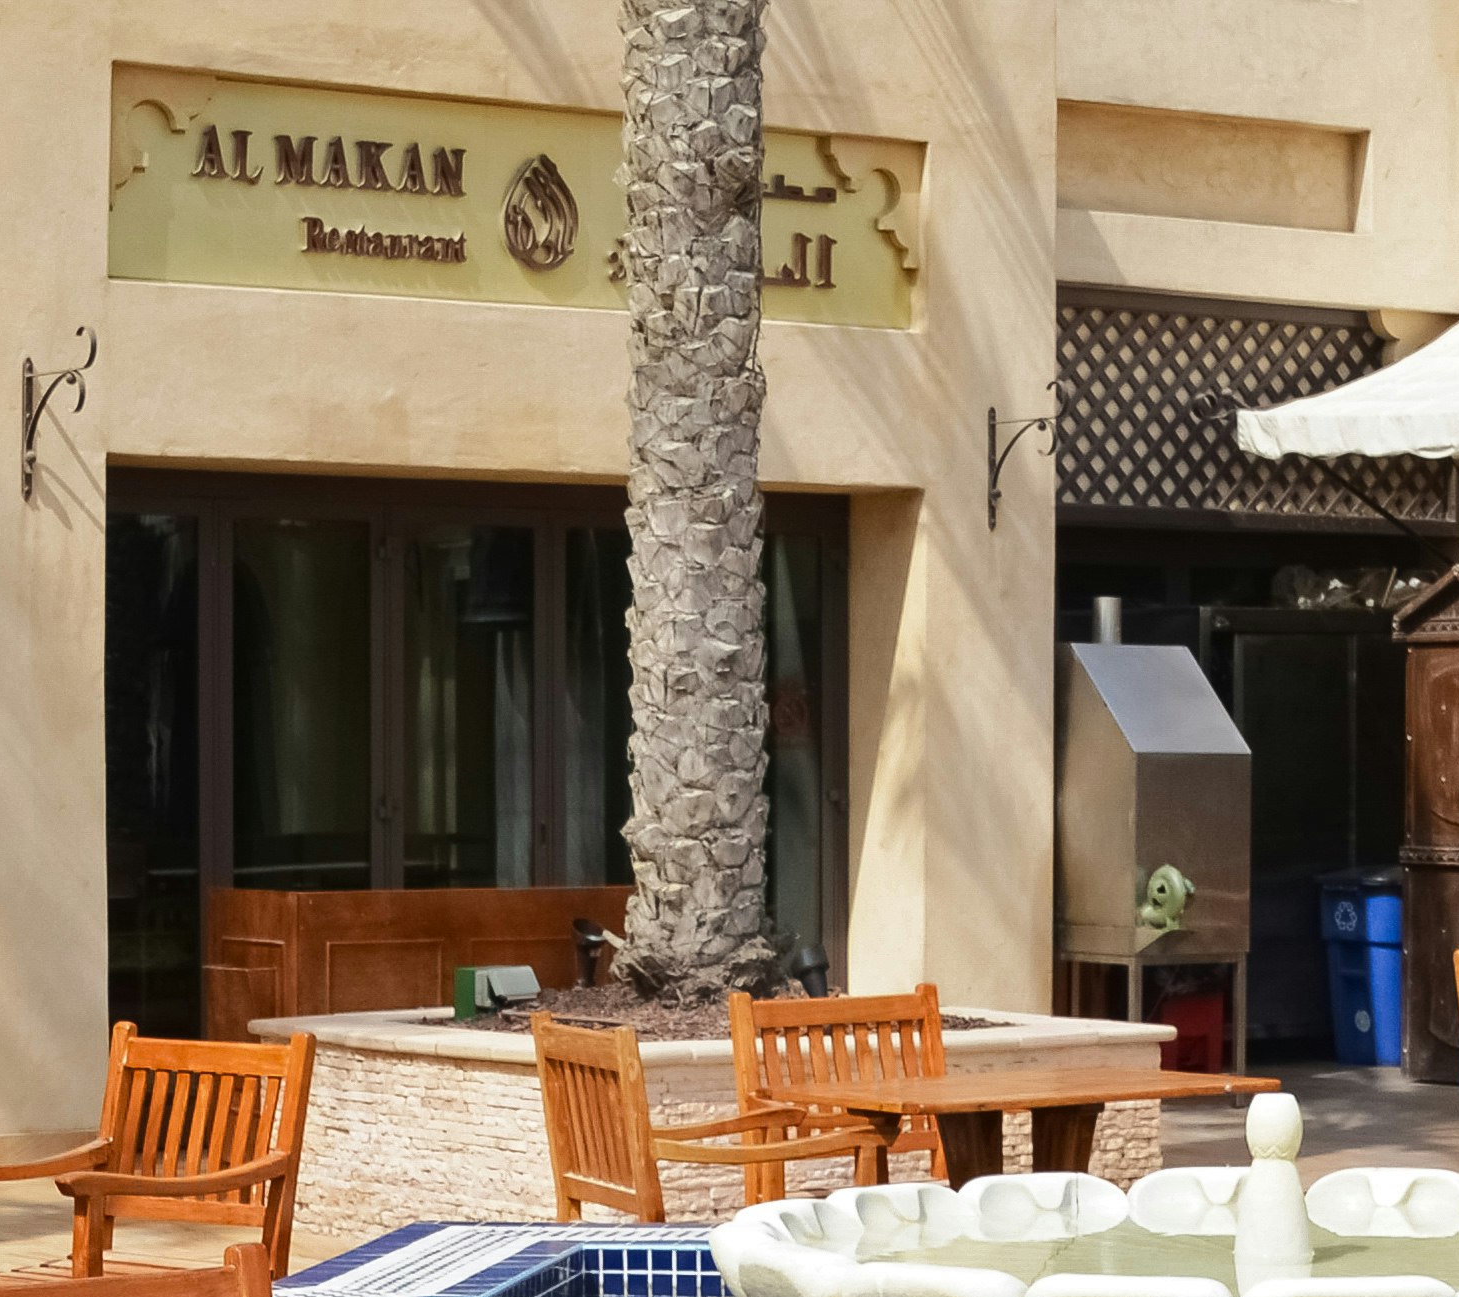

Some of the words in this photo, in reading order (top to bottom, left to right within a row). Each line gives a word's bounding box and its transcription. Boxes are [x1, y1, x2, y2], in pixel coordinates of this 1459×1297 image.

[191, 124, 264, 185] AL
[273, 135, 468, 197] MAKAN
[300, 216, 468, 263] Restaurant
